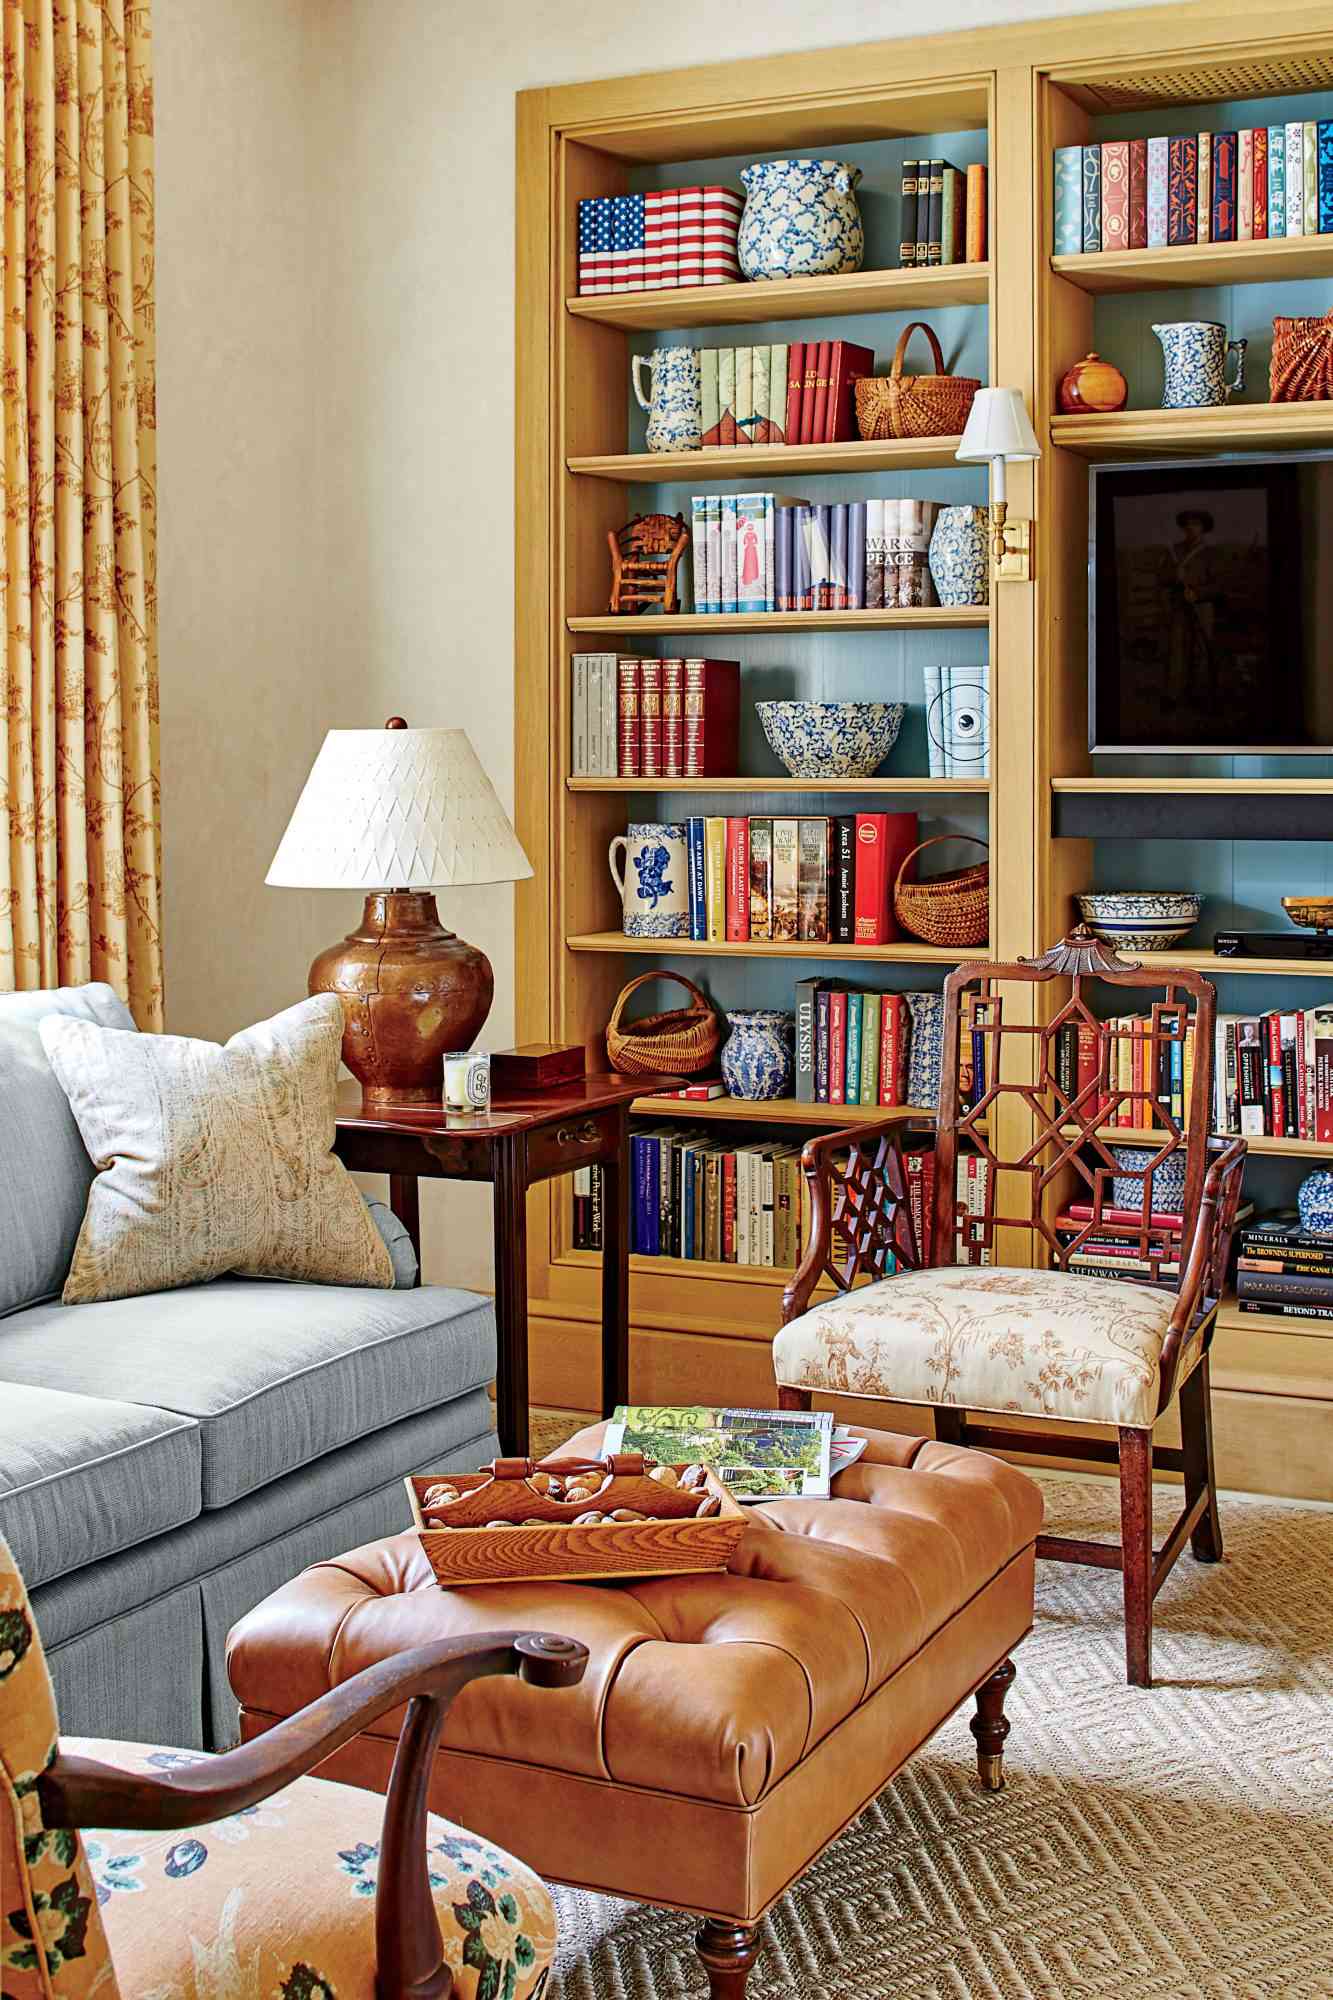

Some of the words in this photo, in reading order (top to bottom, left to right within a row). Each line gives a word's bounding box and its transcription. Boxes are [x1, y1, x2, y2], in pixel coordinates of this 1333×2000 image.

[866, 536, 900, 550] WAR
[903, 537, 913, 550] &
[866, 552, 914, 566] PEACE
[841, 826, 850, 846] Area
[696, 840, 702, 850] AN
[842, 848, 851, 860] 51
[738, 866, 745, 874] AT
[841, 868, 849, 889] Annie
[840, 890, 850, 919] Jacobsen
[1271, 1020, 1279, 1034] John
[799, 1002, 812, 1072] ULYSSES
[1271, 1036, 1280, 1062] Grisham
[1242, 1052, 1251, 1099] OPPENHEIMER
[1298, 1064, 1306, 1097] CATHOLICS
[914, 1181, 922, 1195] THE
[725, 1176, 734, 1240] BASILICA
[592, 1213, 601, 1233] Work
[1247, 1233, 1289, 1244] MINERALS
[1257, 1248, 1288, 1258] BROWNING
[1069, 1266, 1121, 1279] STEINWAY
[1283, 1305, 1317, 1316] BEYOND
